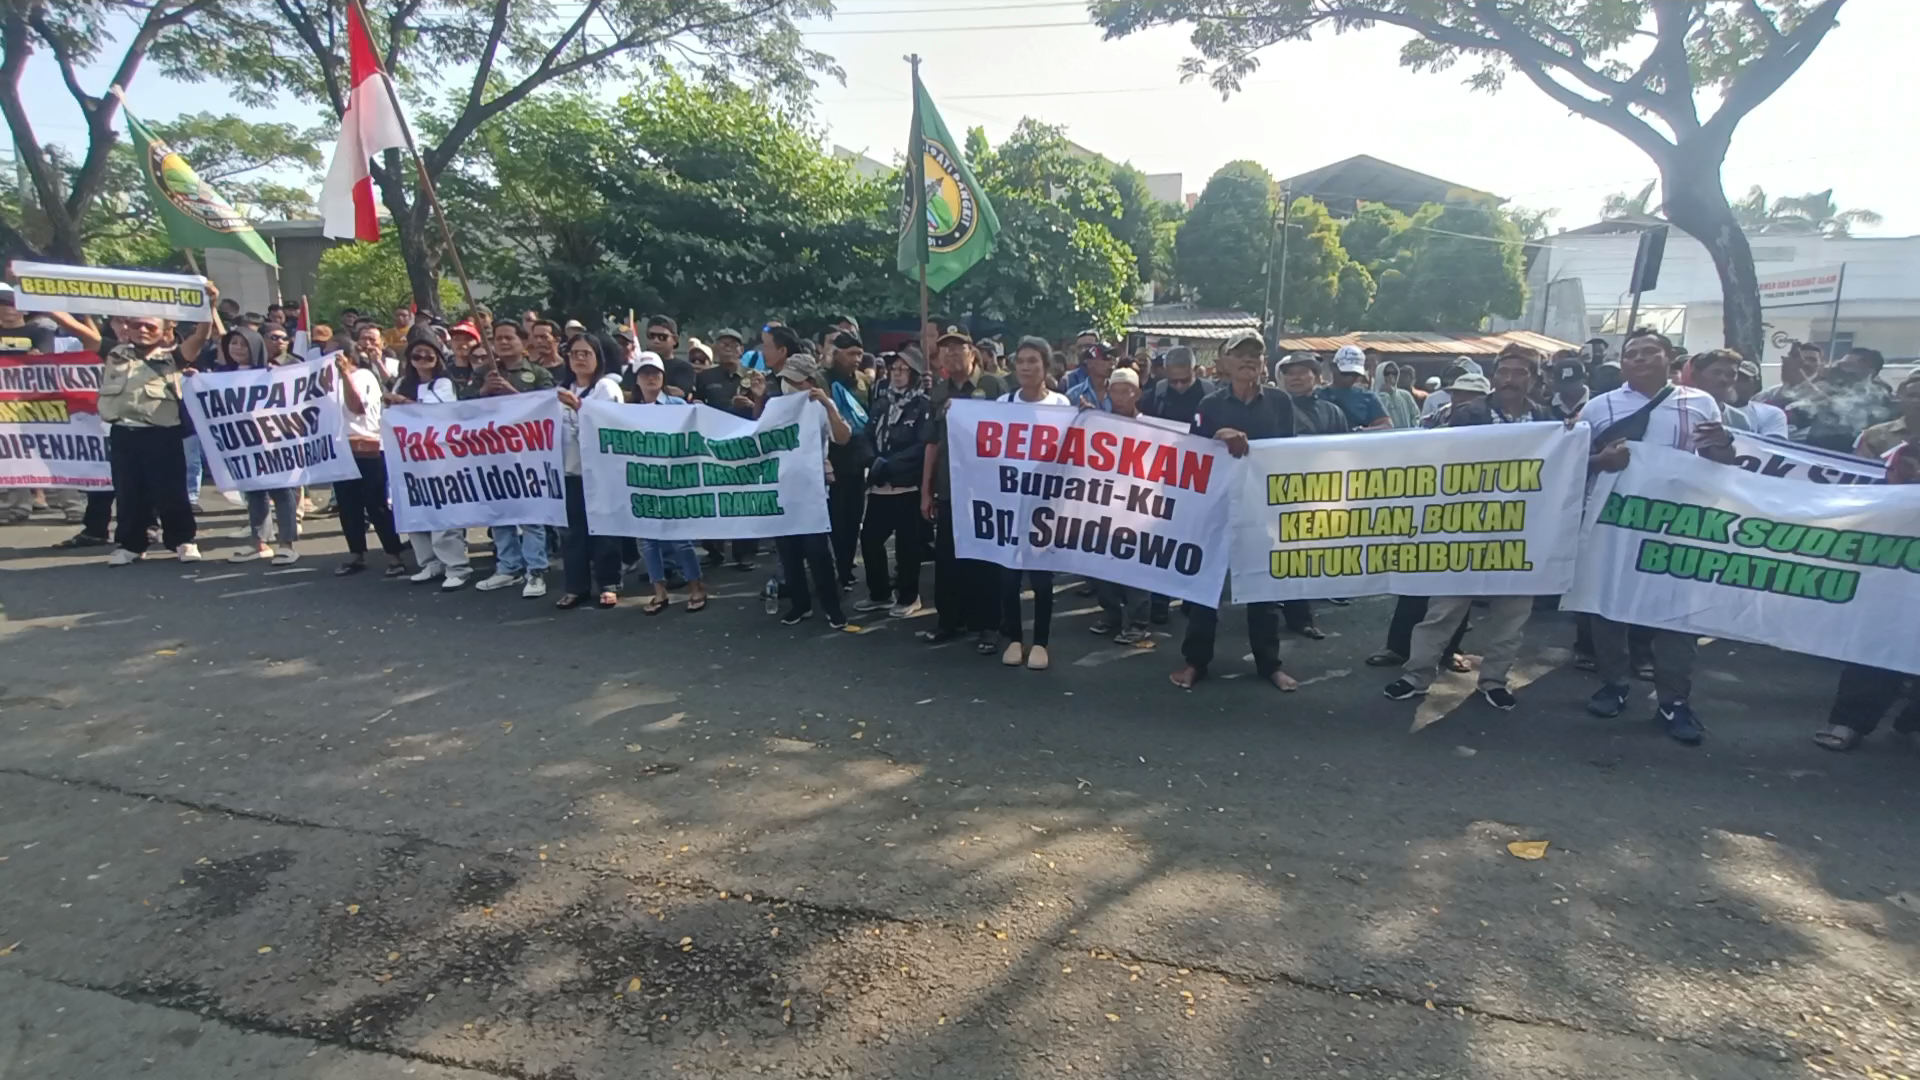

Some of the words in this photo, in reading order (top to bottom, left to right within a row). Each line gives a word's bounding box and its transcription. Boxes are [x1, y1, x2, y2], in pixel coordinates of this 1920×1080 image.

[20, 276, 116, 298] BEBASKAN
[115, 282, 204, 307] BUPATI-KU
[197, 382, 286, 419] TANPA
[209, 406, 320, 451] SUDEWO
[393, 426, 446, 463] Pak
[445, 419, 555, 458] Sudewo
[976, 420, 1215, 494] BEBASKAN
[404, 467, 480, 510] Bupati
[999, 465, 1176, 521] Bupati-Ku
[1267, 471, 1343, 505] KAMI
[1346, 465, 1436, 500] HADIR
[1441, 459, 1544, 495] UNTUK
[972, 500, 1019, 547] Bp.
[1028, 506, 1203, 576] Sudewo
[1279, 506, 1417, 542] KEADILAN,
[1421, 501, 1526, 533] BUKAN
[1269, 545, 1362, 579] UNTUK
[1366, 540, 1533, 574] KERIBUTAN.
[1635, 539, 1860, 604] BUPATIKU
